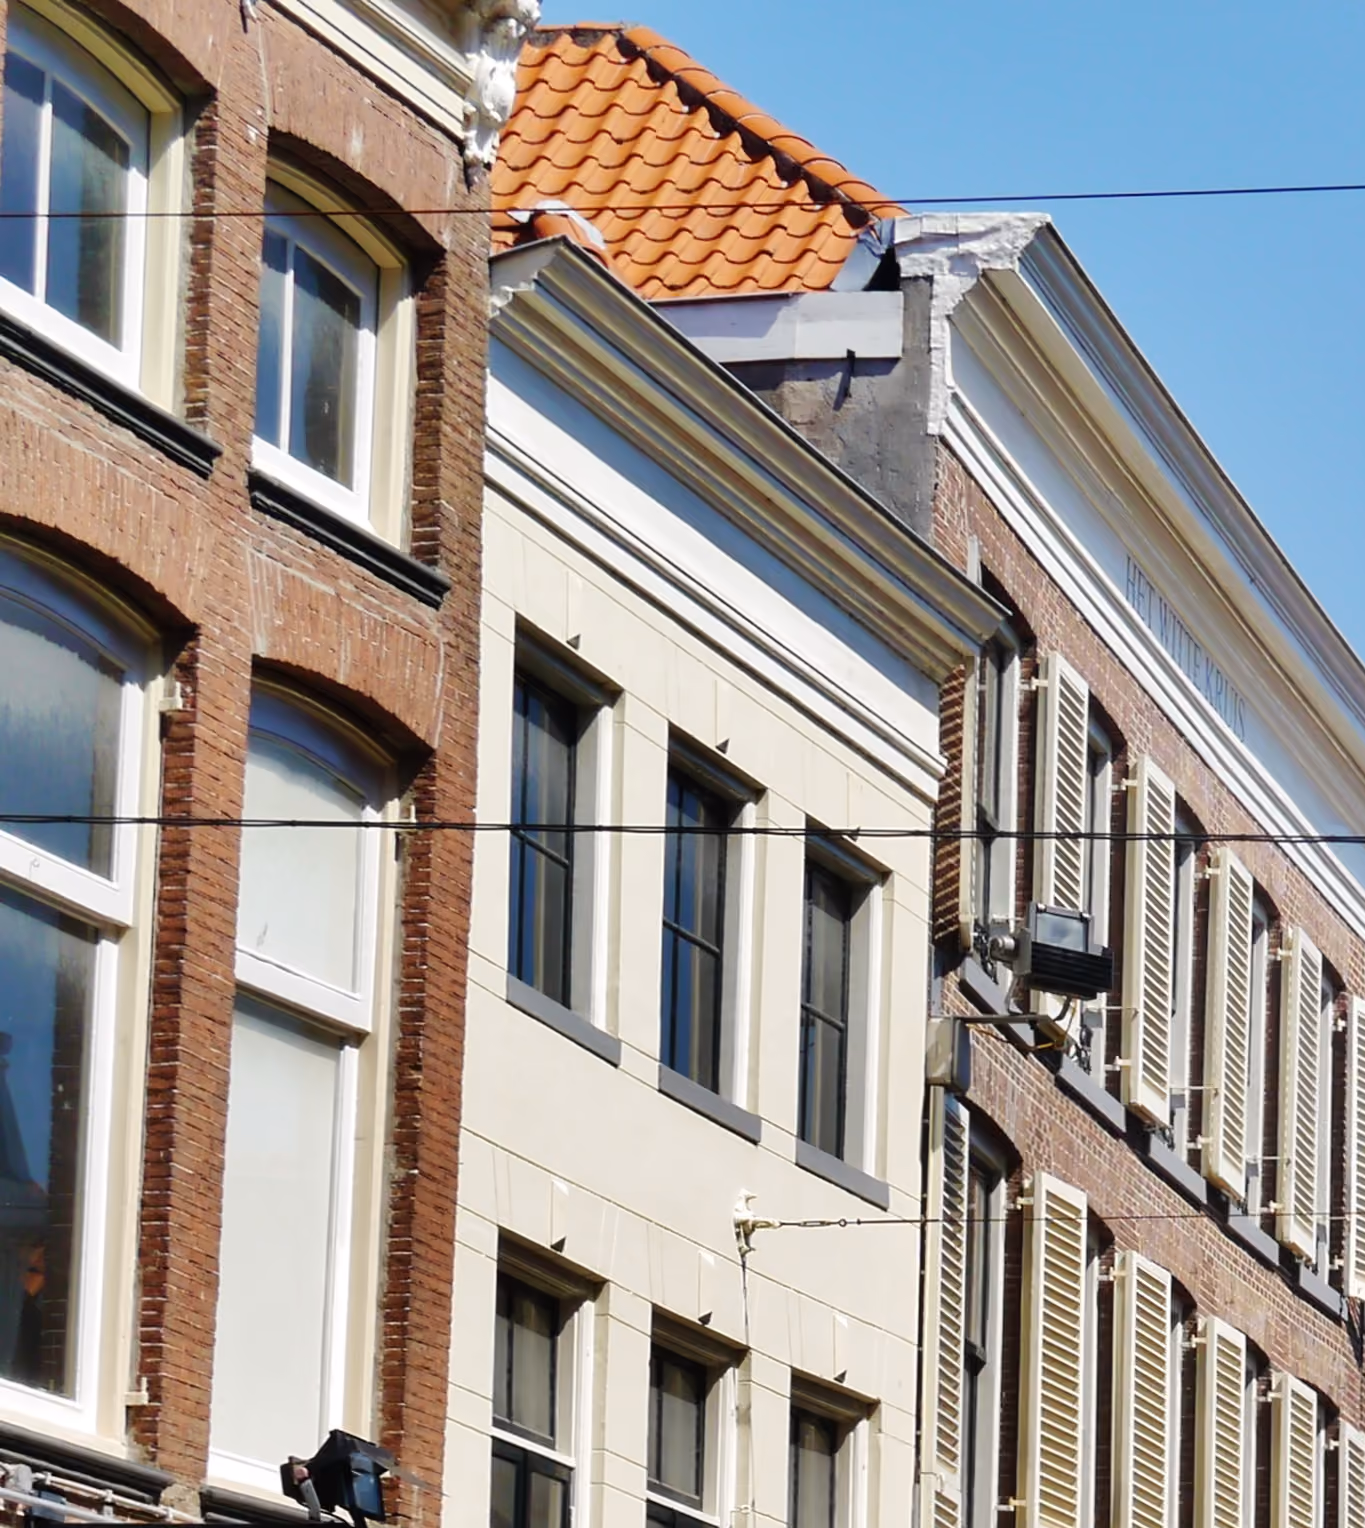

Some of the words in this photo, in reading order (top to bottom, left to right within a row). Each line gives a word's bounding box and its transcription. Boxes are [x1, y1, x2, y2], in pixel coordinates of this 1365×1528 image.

[1126, 555, 1155, 629] HET
[1159, 597, 1201, 692] WITTE
[1205, 656, 1246, 742] KRUIS
